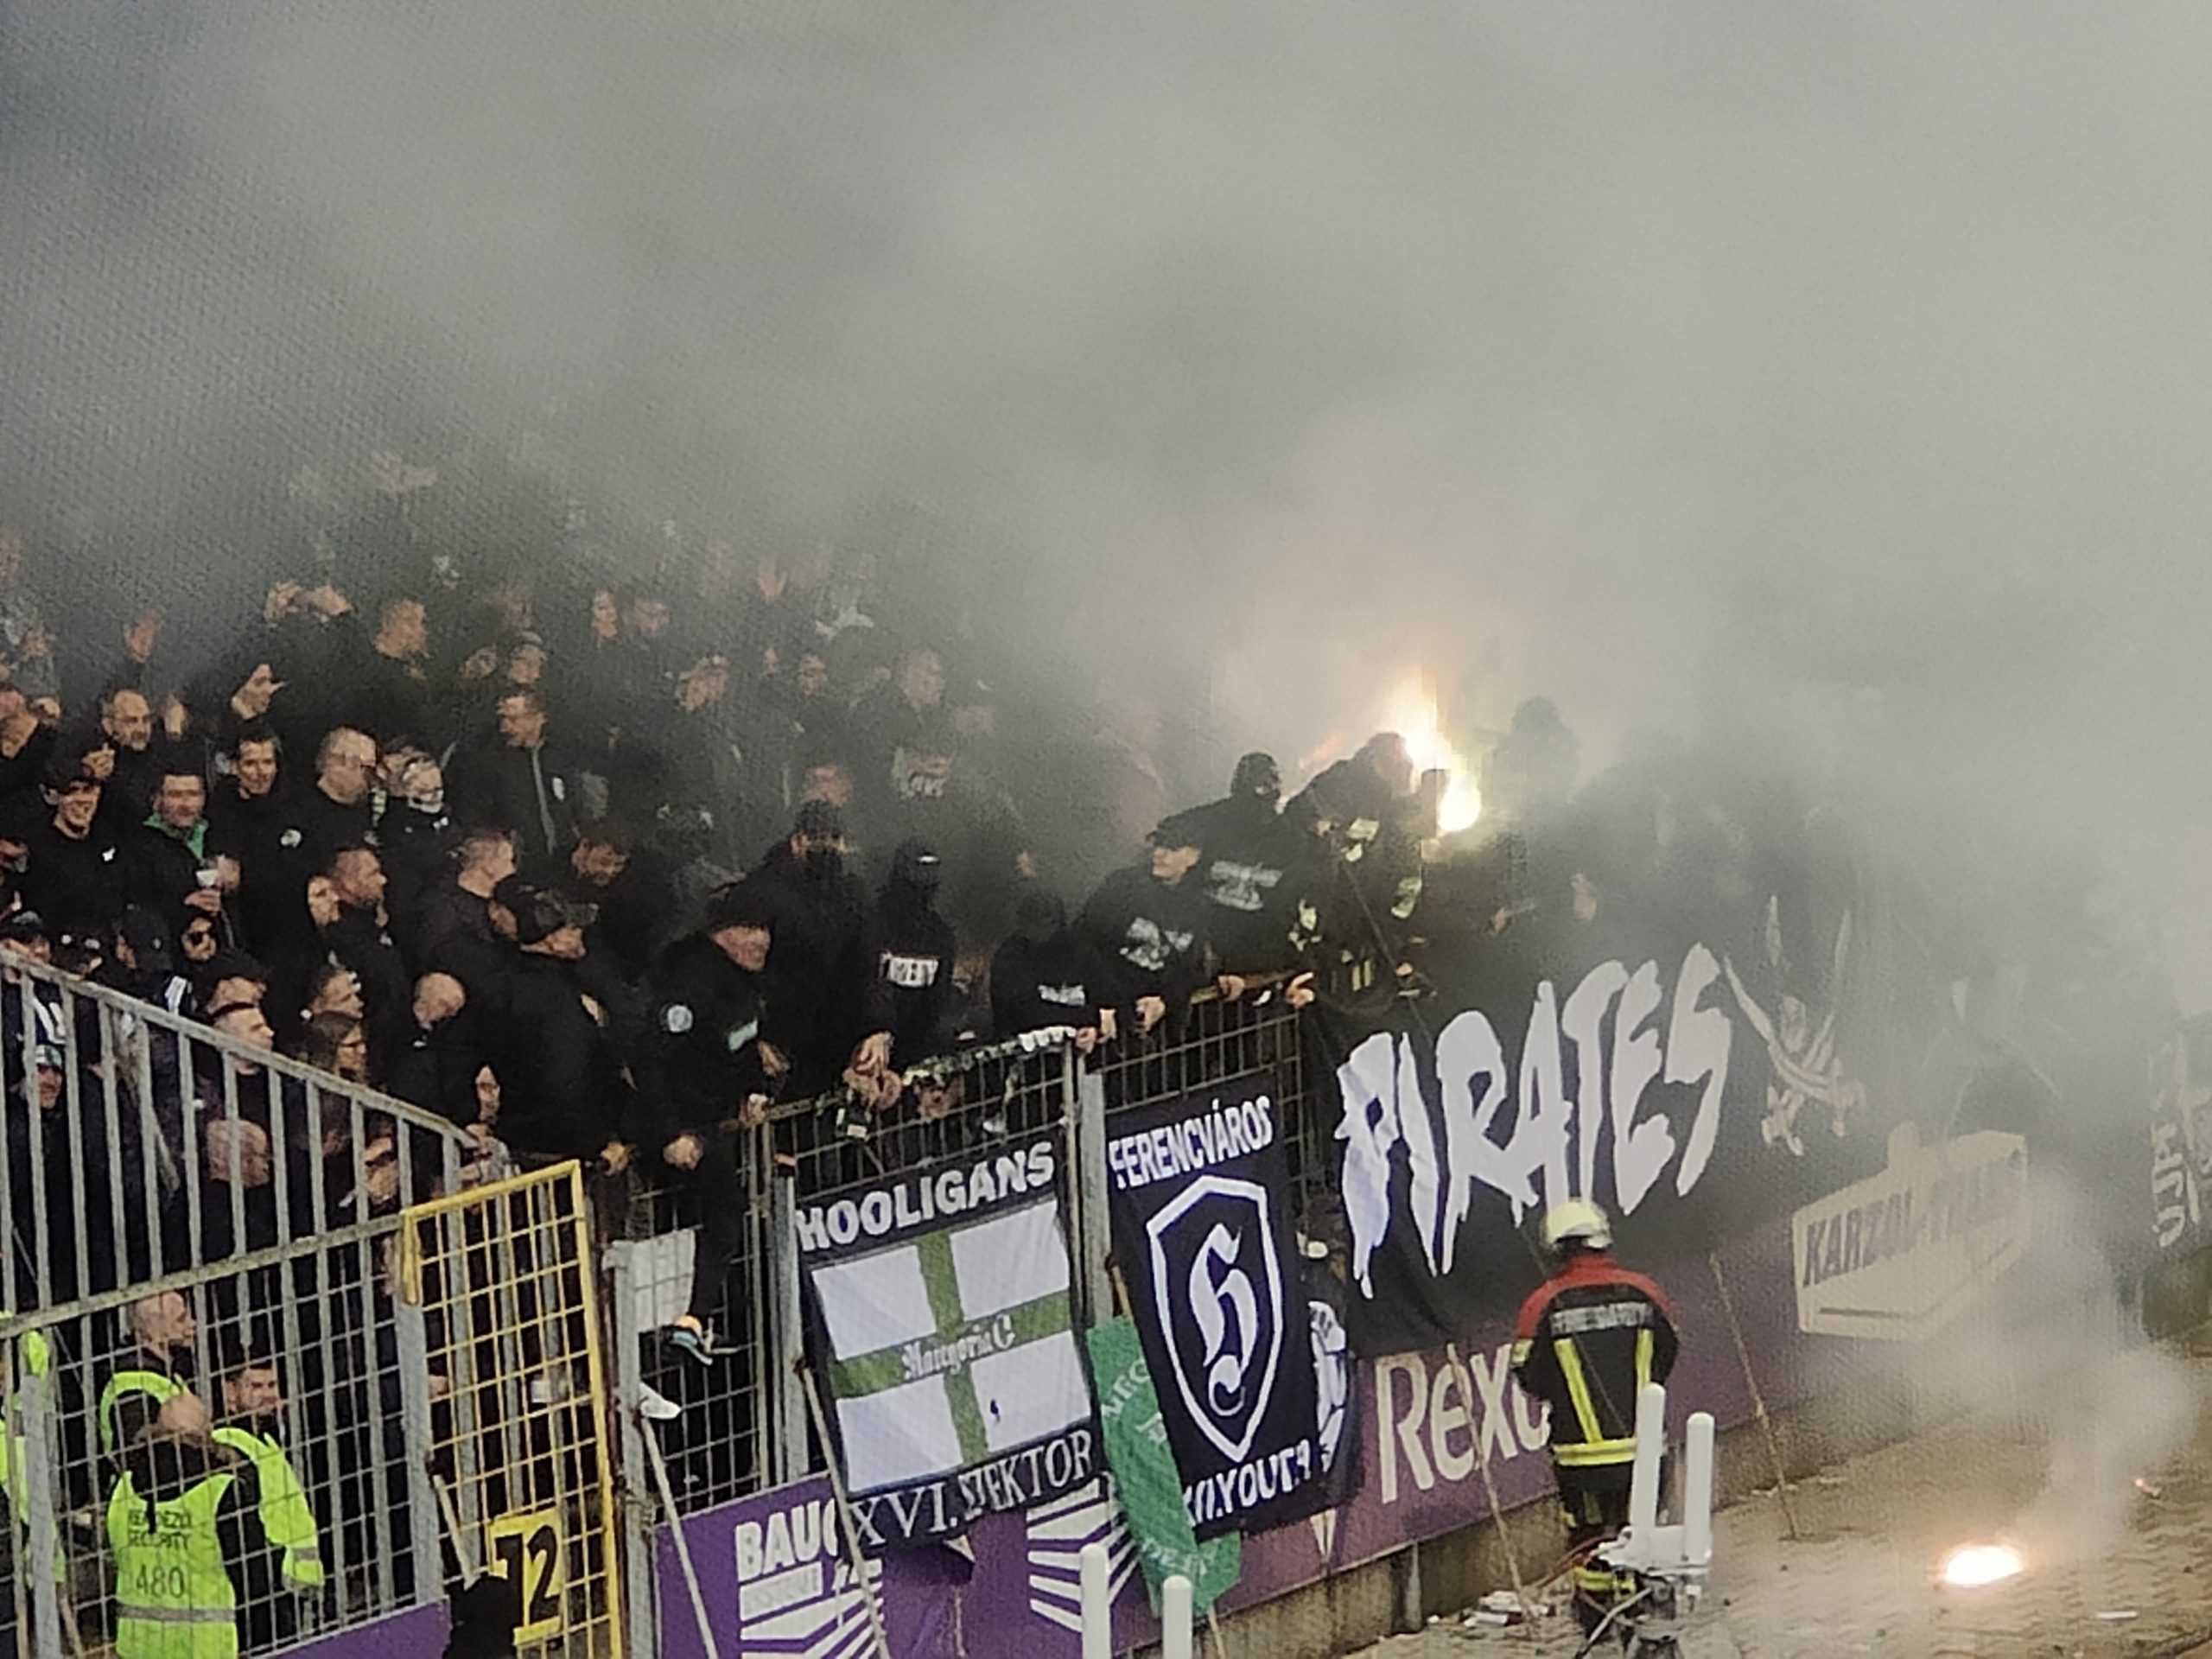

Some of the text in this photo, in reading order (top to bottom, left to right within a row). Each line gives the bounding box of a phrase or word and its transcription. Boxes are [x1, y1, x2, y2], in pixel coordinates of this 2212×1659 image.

[1334, 942, 1732, 1298] PIRATES
[796, 1141, 1054, 1251] HOOLIGANS
[136, 1563, 185, 1599] 480
